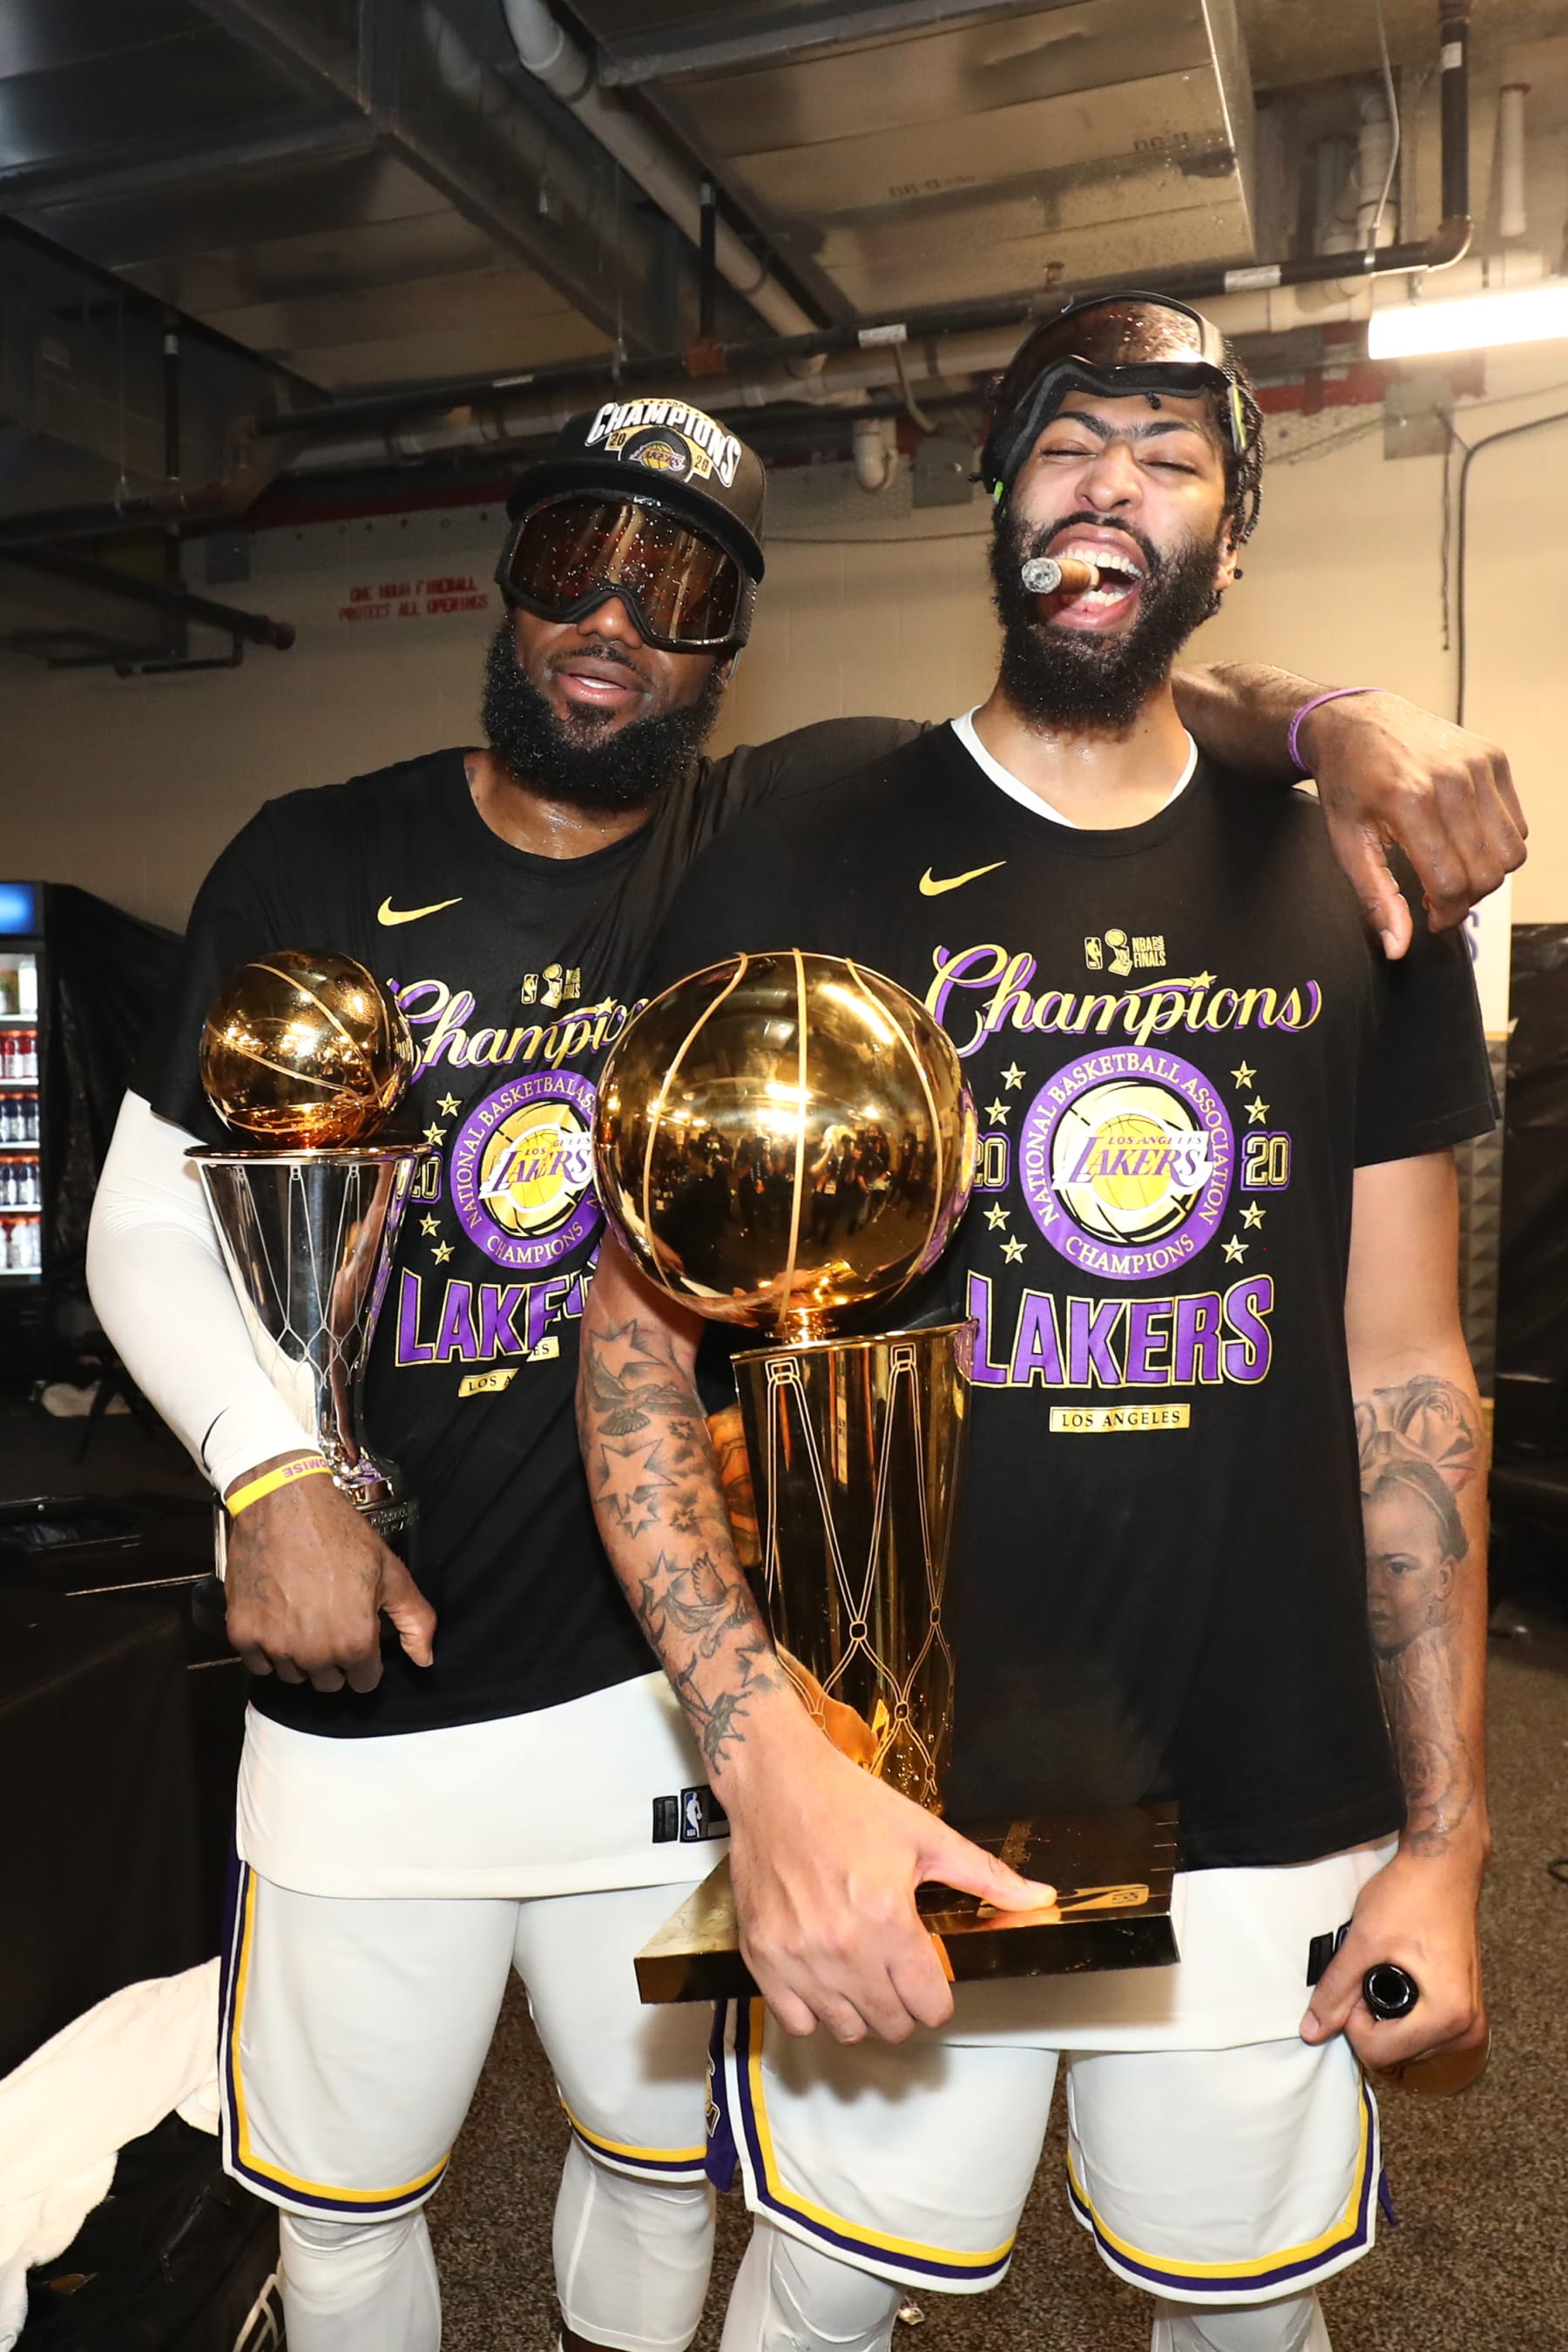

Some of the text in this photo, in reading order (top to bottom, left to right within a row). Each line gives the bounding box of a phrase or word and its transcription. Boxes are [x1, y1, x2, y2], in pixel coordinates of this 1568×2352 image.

[585, 402, 741, 488] CHAMPIONS
[1132, 936, 1152, 952] NBA
[1133, 950, 1166, 968] FINALS
[923, 944, 1322, 1058] Champions
[385, 977, 649, 1085] Champio
[1024, 1052, 1229, 1227] NATIONAL BASKETBALL ASSOCIATION
[1068, 1136, 1201, 1188] LAKERS
[1108, 1135, 1133, 1145] LOS
[1243, 1134, 1290, 1188] 20
[456, 1127, 486, 1229] NATIONAL
[486, 1220, 585, 1263] CHAMPIONS
[1065, 1233, 1194, 1274] CHAMPIONS
[967, 1270, 1274, 1389] LAKERS
[469, 1375, 497, 1391] LOS
[1062, 1410, 1181, 1427] LOS ANGELES
